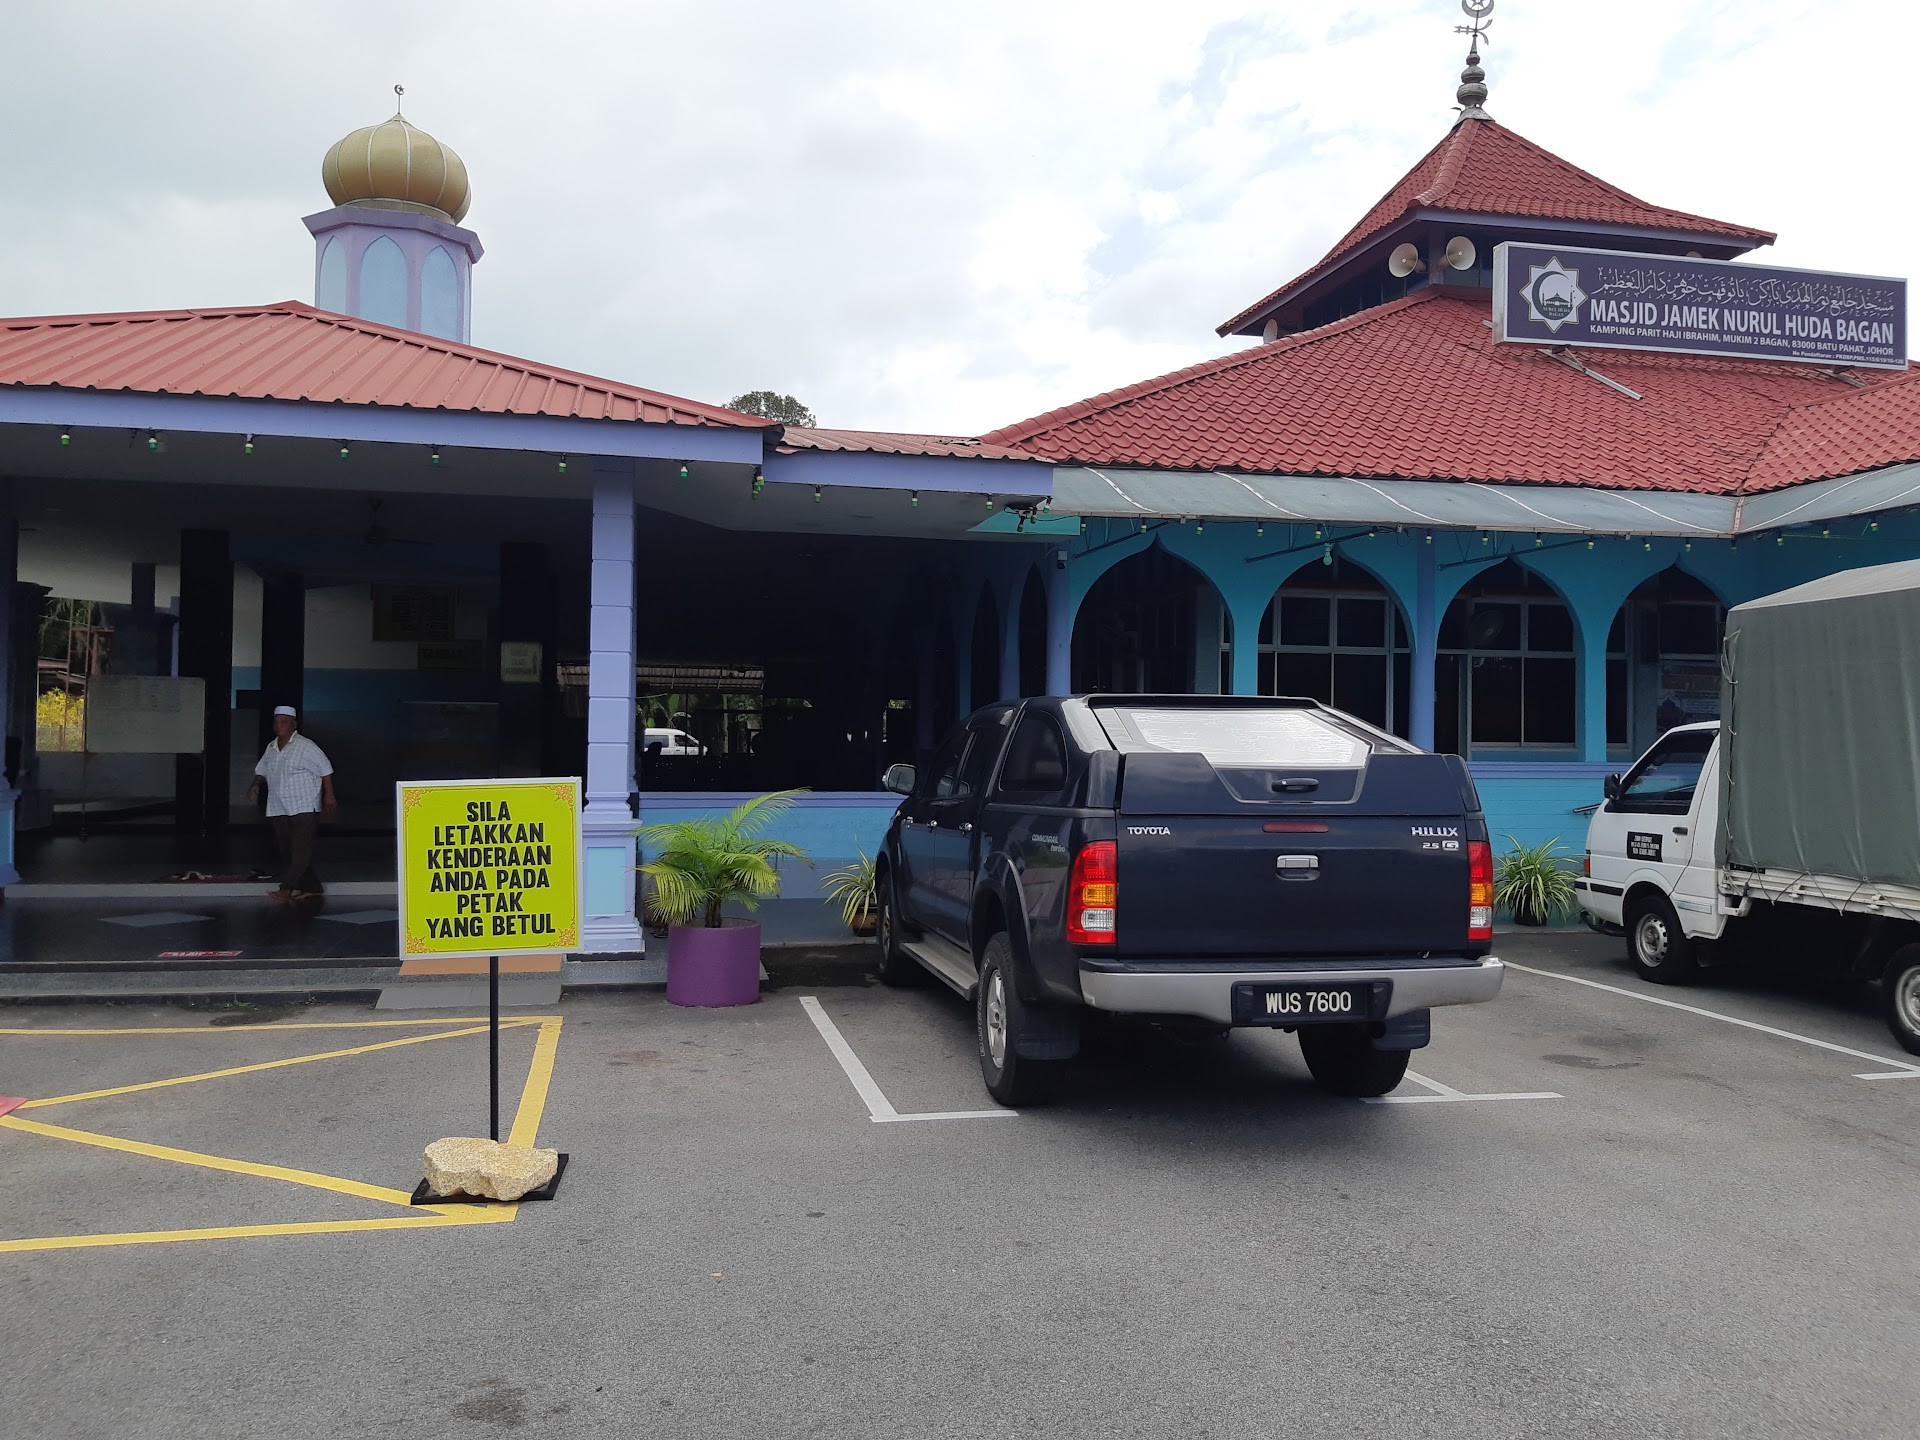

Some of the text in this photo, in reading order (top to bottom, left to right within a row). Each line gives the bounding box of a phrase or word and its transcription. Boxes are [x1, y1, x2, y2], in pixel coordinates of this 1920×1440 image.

[1590, 298, 1894, 345] MASJID JAMEK NURUL HUDA BAGAN
[1590, 324, 1894, 356] KAMPUNG PARIT HAJI IBRAHIM, MUKIM 2 BAGAN, 83000 BATU PAHAT, JOHOR
[466, 801, 511, 823] SILA
[434, 822, 544, 847] LETAKKAN
[1126, 826, 1171, 835] TOYOTA
[1411, 826, 1459, 837] HILUX
[427, 845, 552, 870] KENDERAAN
[430, 867, 550, 893] ANDA PADA
[457, 892, 524, 915] PETAK
[426, 913, 556, 939] YANG BETUL
[1265, 991, 1352, 1014] WUS 7600
